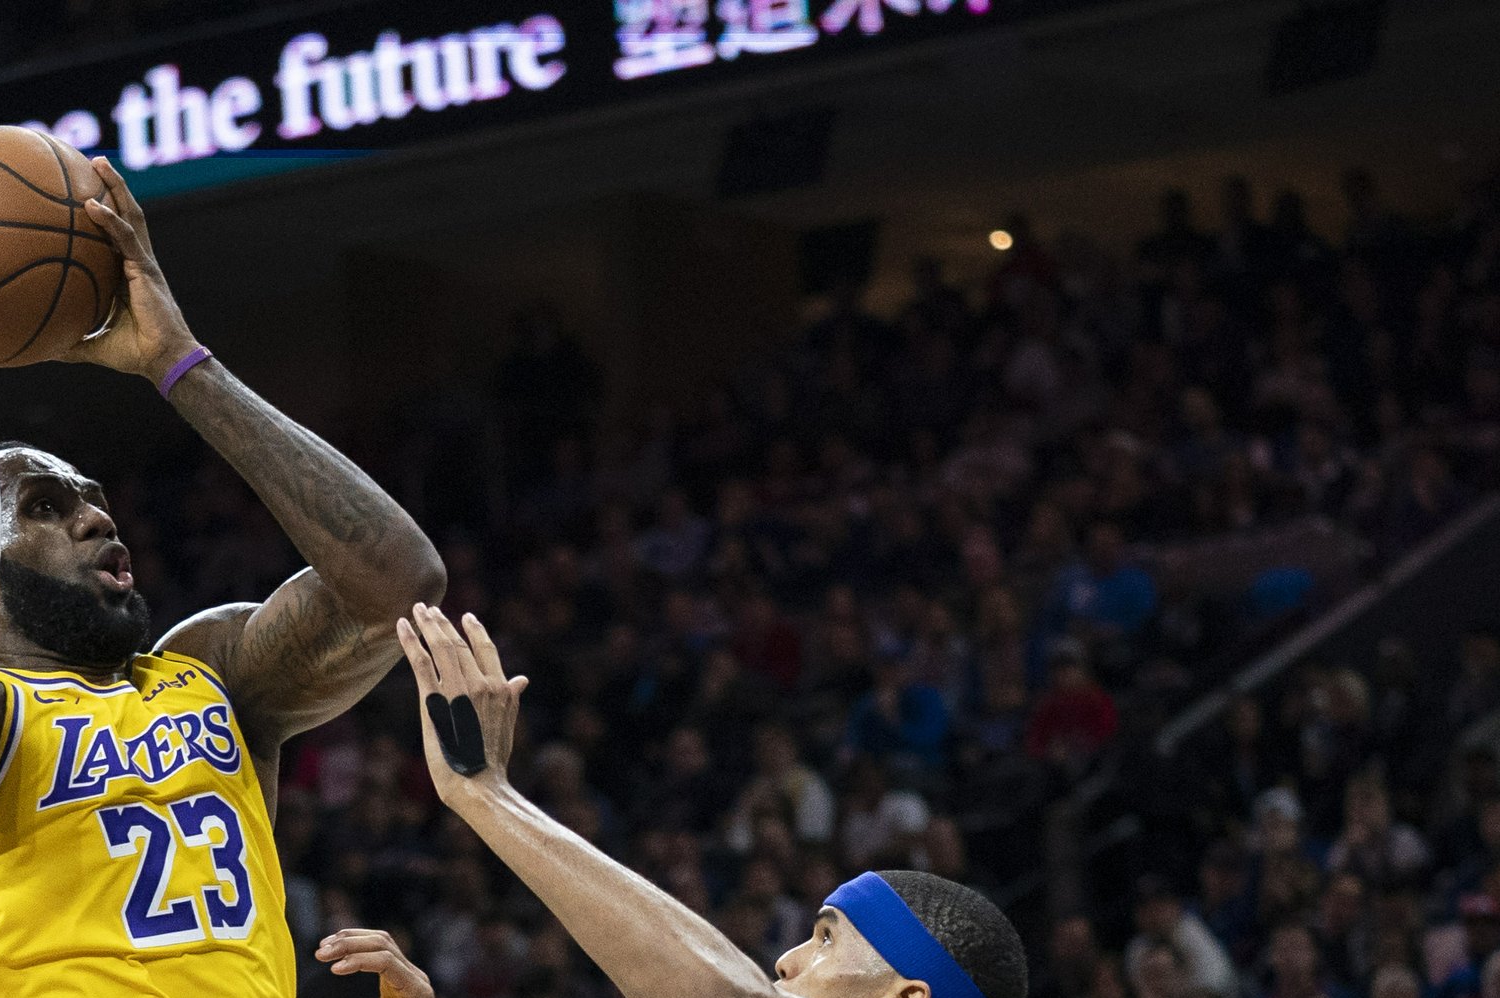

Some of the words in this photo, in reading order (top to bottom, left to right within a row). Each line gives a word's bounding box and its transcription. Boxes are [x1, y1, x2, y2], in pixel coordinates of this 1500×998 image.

[111, 63, 261, 171] the
[274, 14, 567, 140] future
[142, 670, 197, 702] wish
[36, 703, 241, 812] LAKERS
[96, 791, 257, 949] 23
